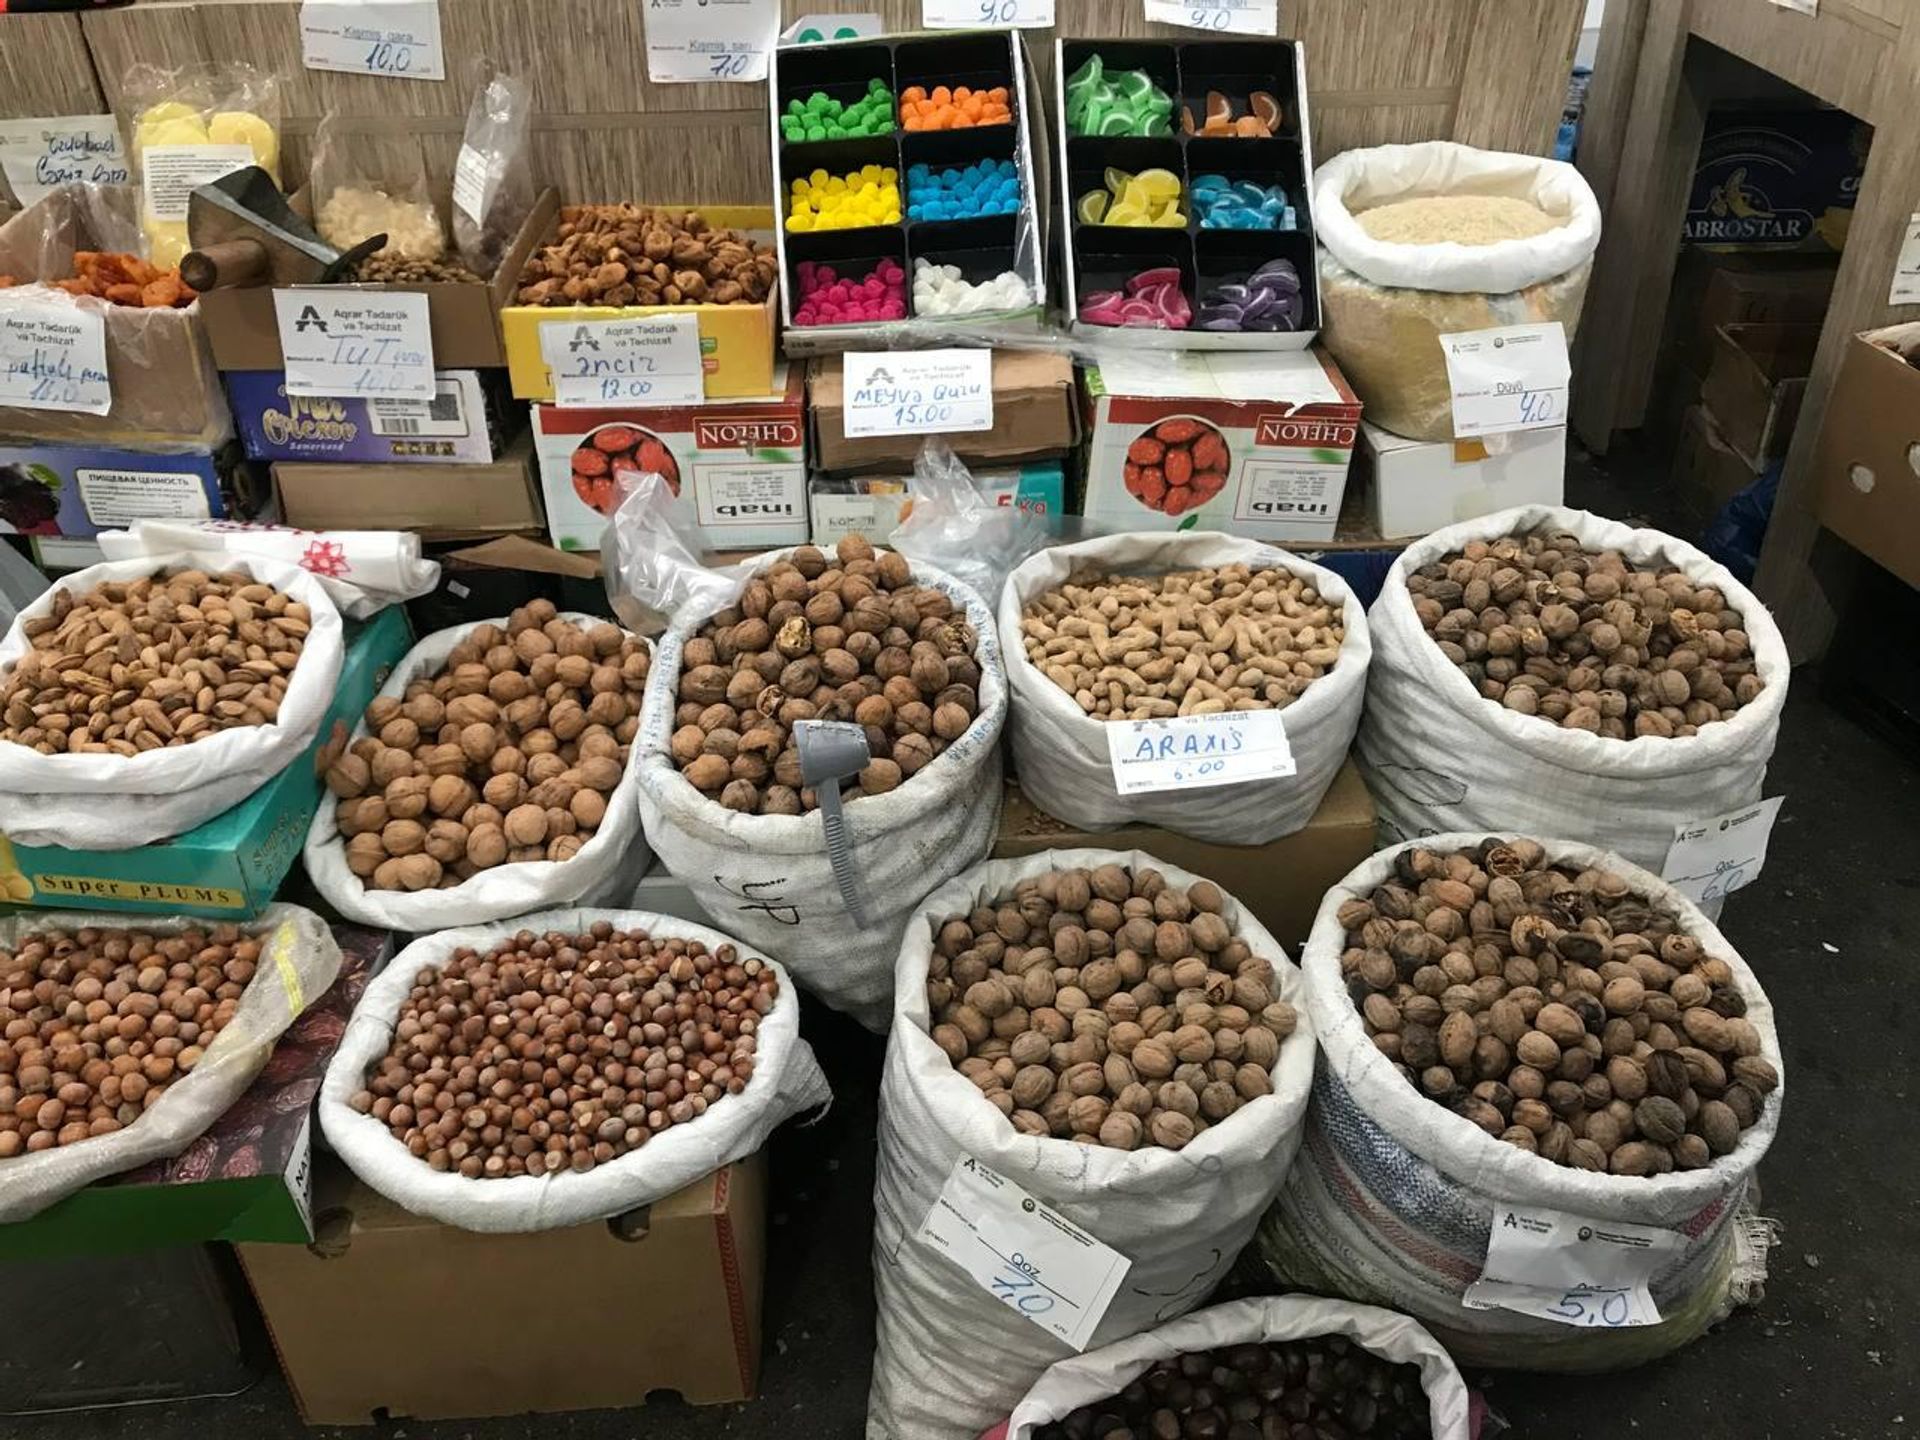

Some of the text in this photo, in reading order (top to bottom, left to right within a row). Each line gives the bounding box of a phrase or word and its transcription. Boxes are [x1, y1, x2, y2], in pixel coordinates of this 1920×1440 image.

[601, 378, 652, 399] 12.00
[1261, 423, 1356, 444] CHELON
[138, 475, 189, 486] ЦЕННОСТЬ
[716, 504, 792, 516] inab
[1252, 502, 1328, 516] inab
[42, 875, 230, 903] Super PLUMS
[1546, 1293, 1628, 1325] 5,0
